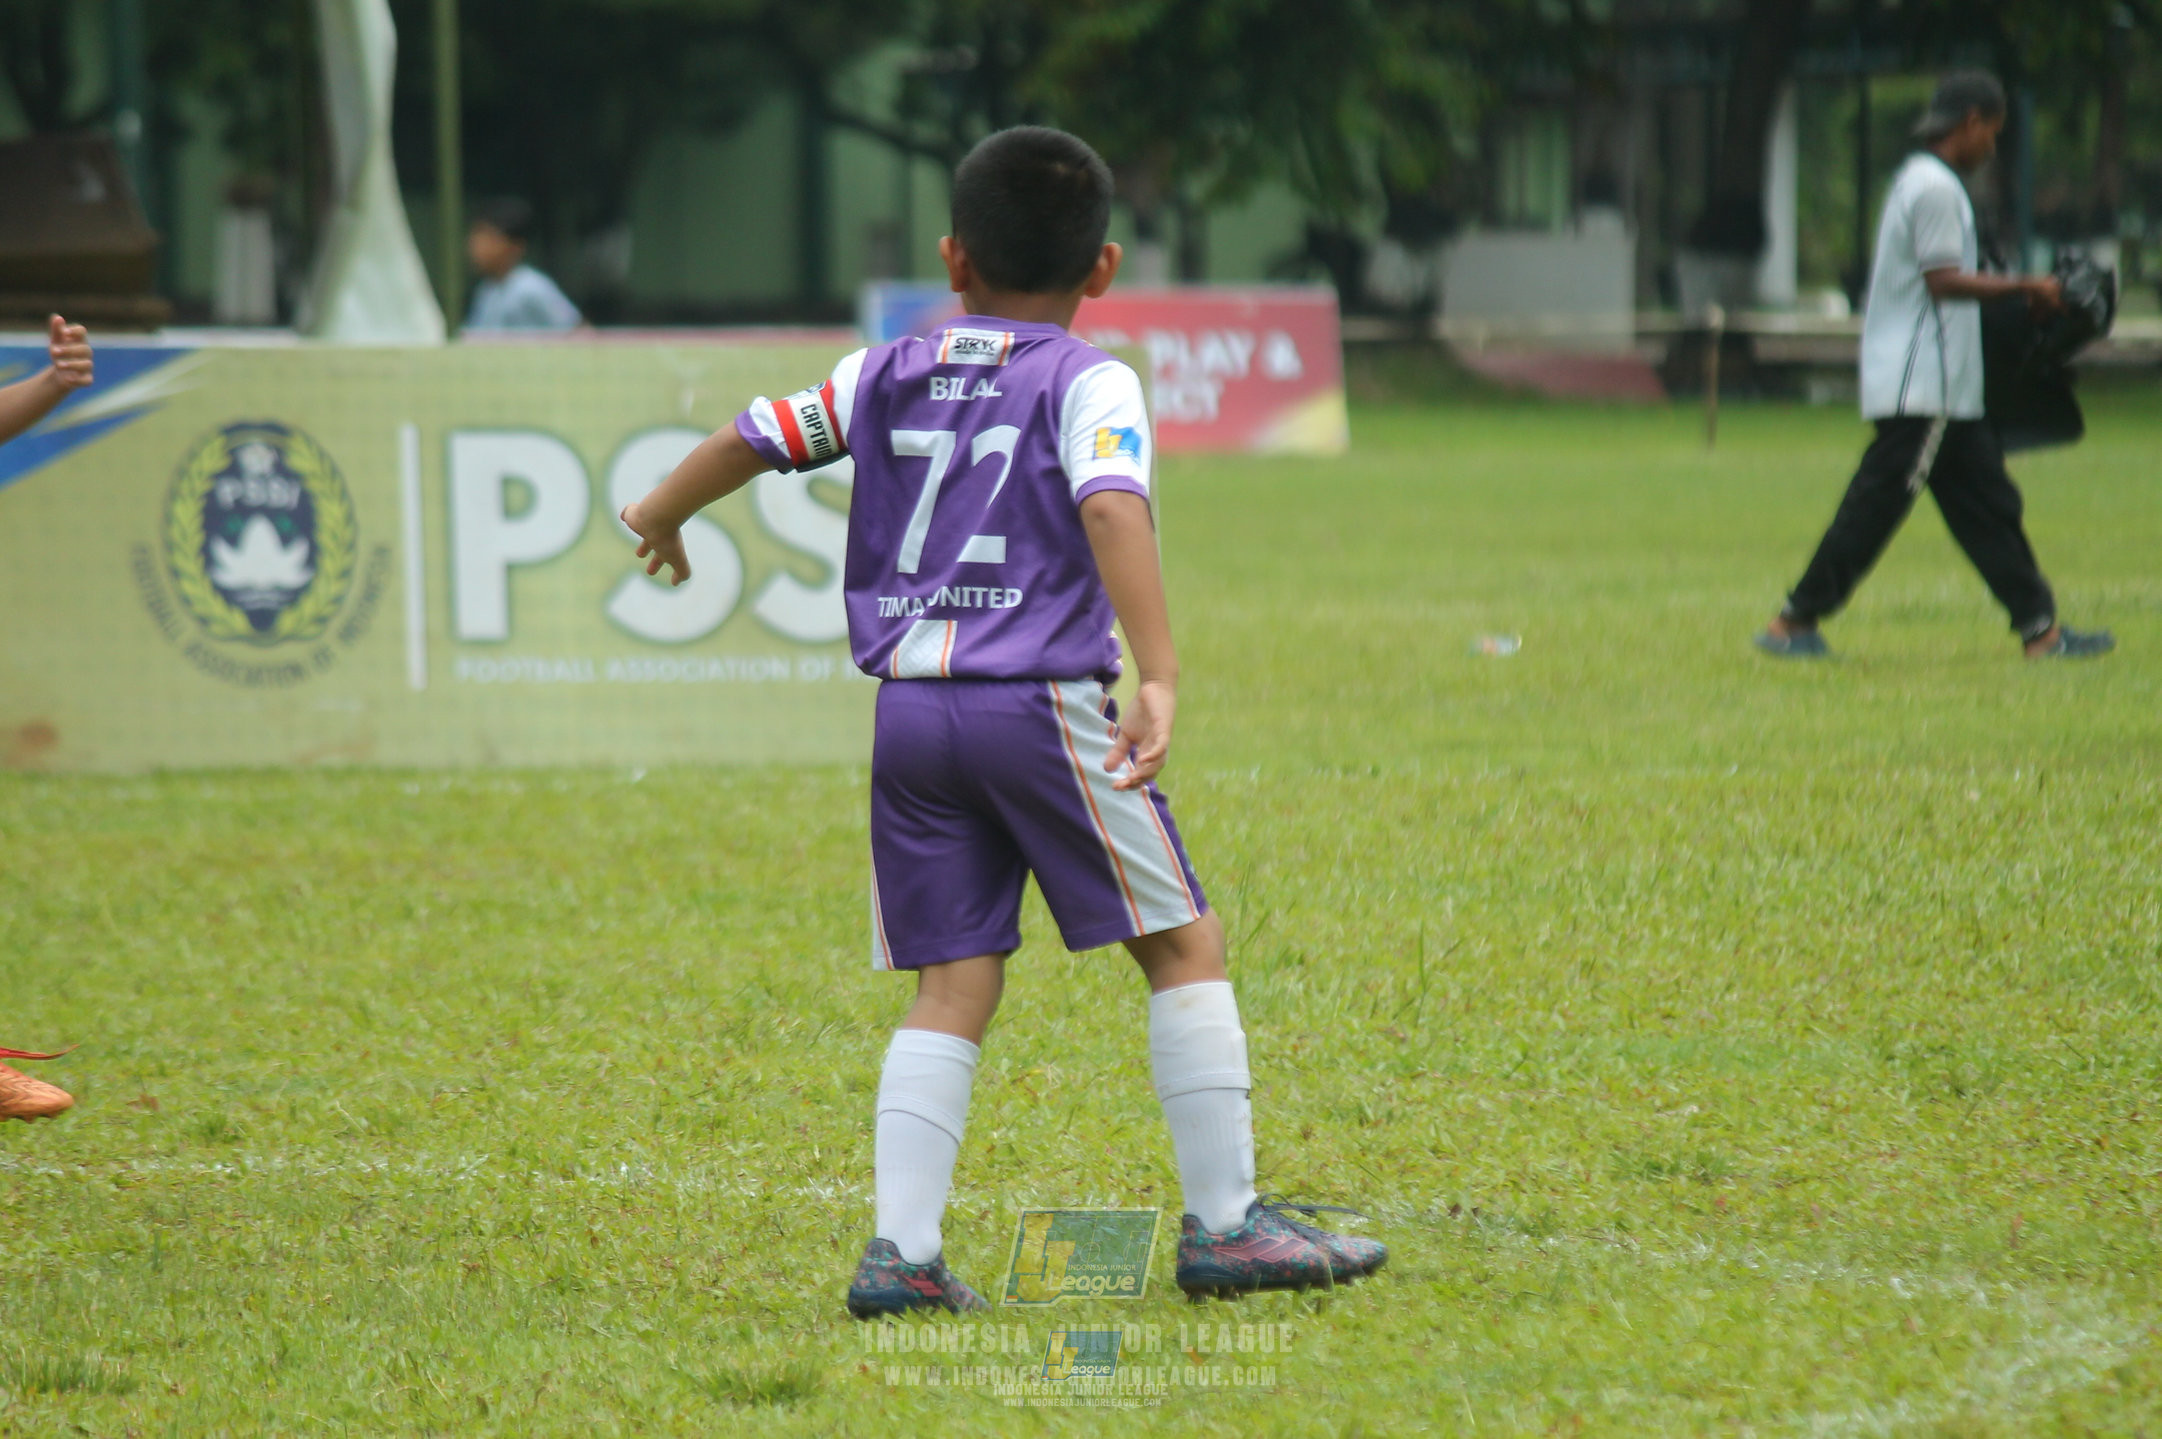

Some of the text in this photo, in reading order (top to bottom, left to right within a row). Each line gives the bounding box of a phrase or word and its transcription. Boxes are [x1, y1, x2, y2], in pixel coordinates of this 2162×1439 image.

[930, 376, 1003, 401] BILAL
[214, 473, 301, 511] PSSI
[890, 424, 1022, 574] 72
[455, 656, 597, 684] FOOTBALL
[606, 655, 793, 684] ASSOCIATION
[799, 656, 837, 683] OF
